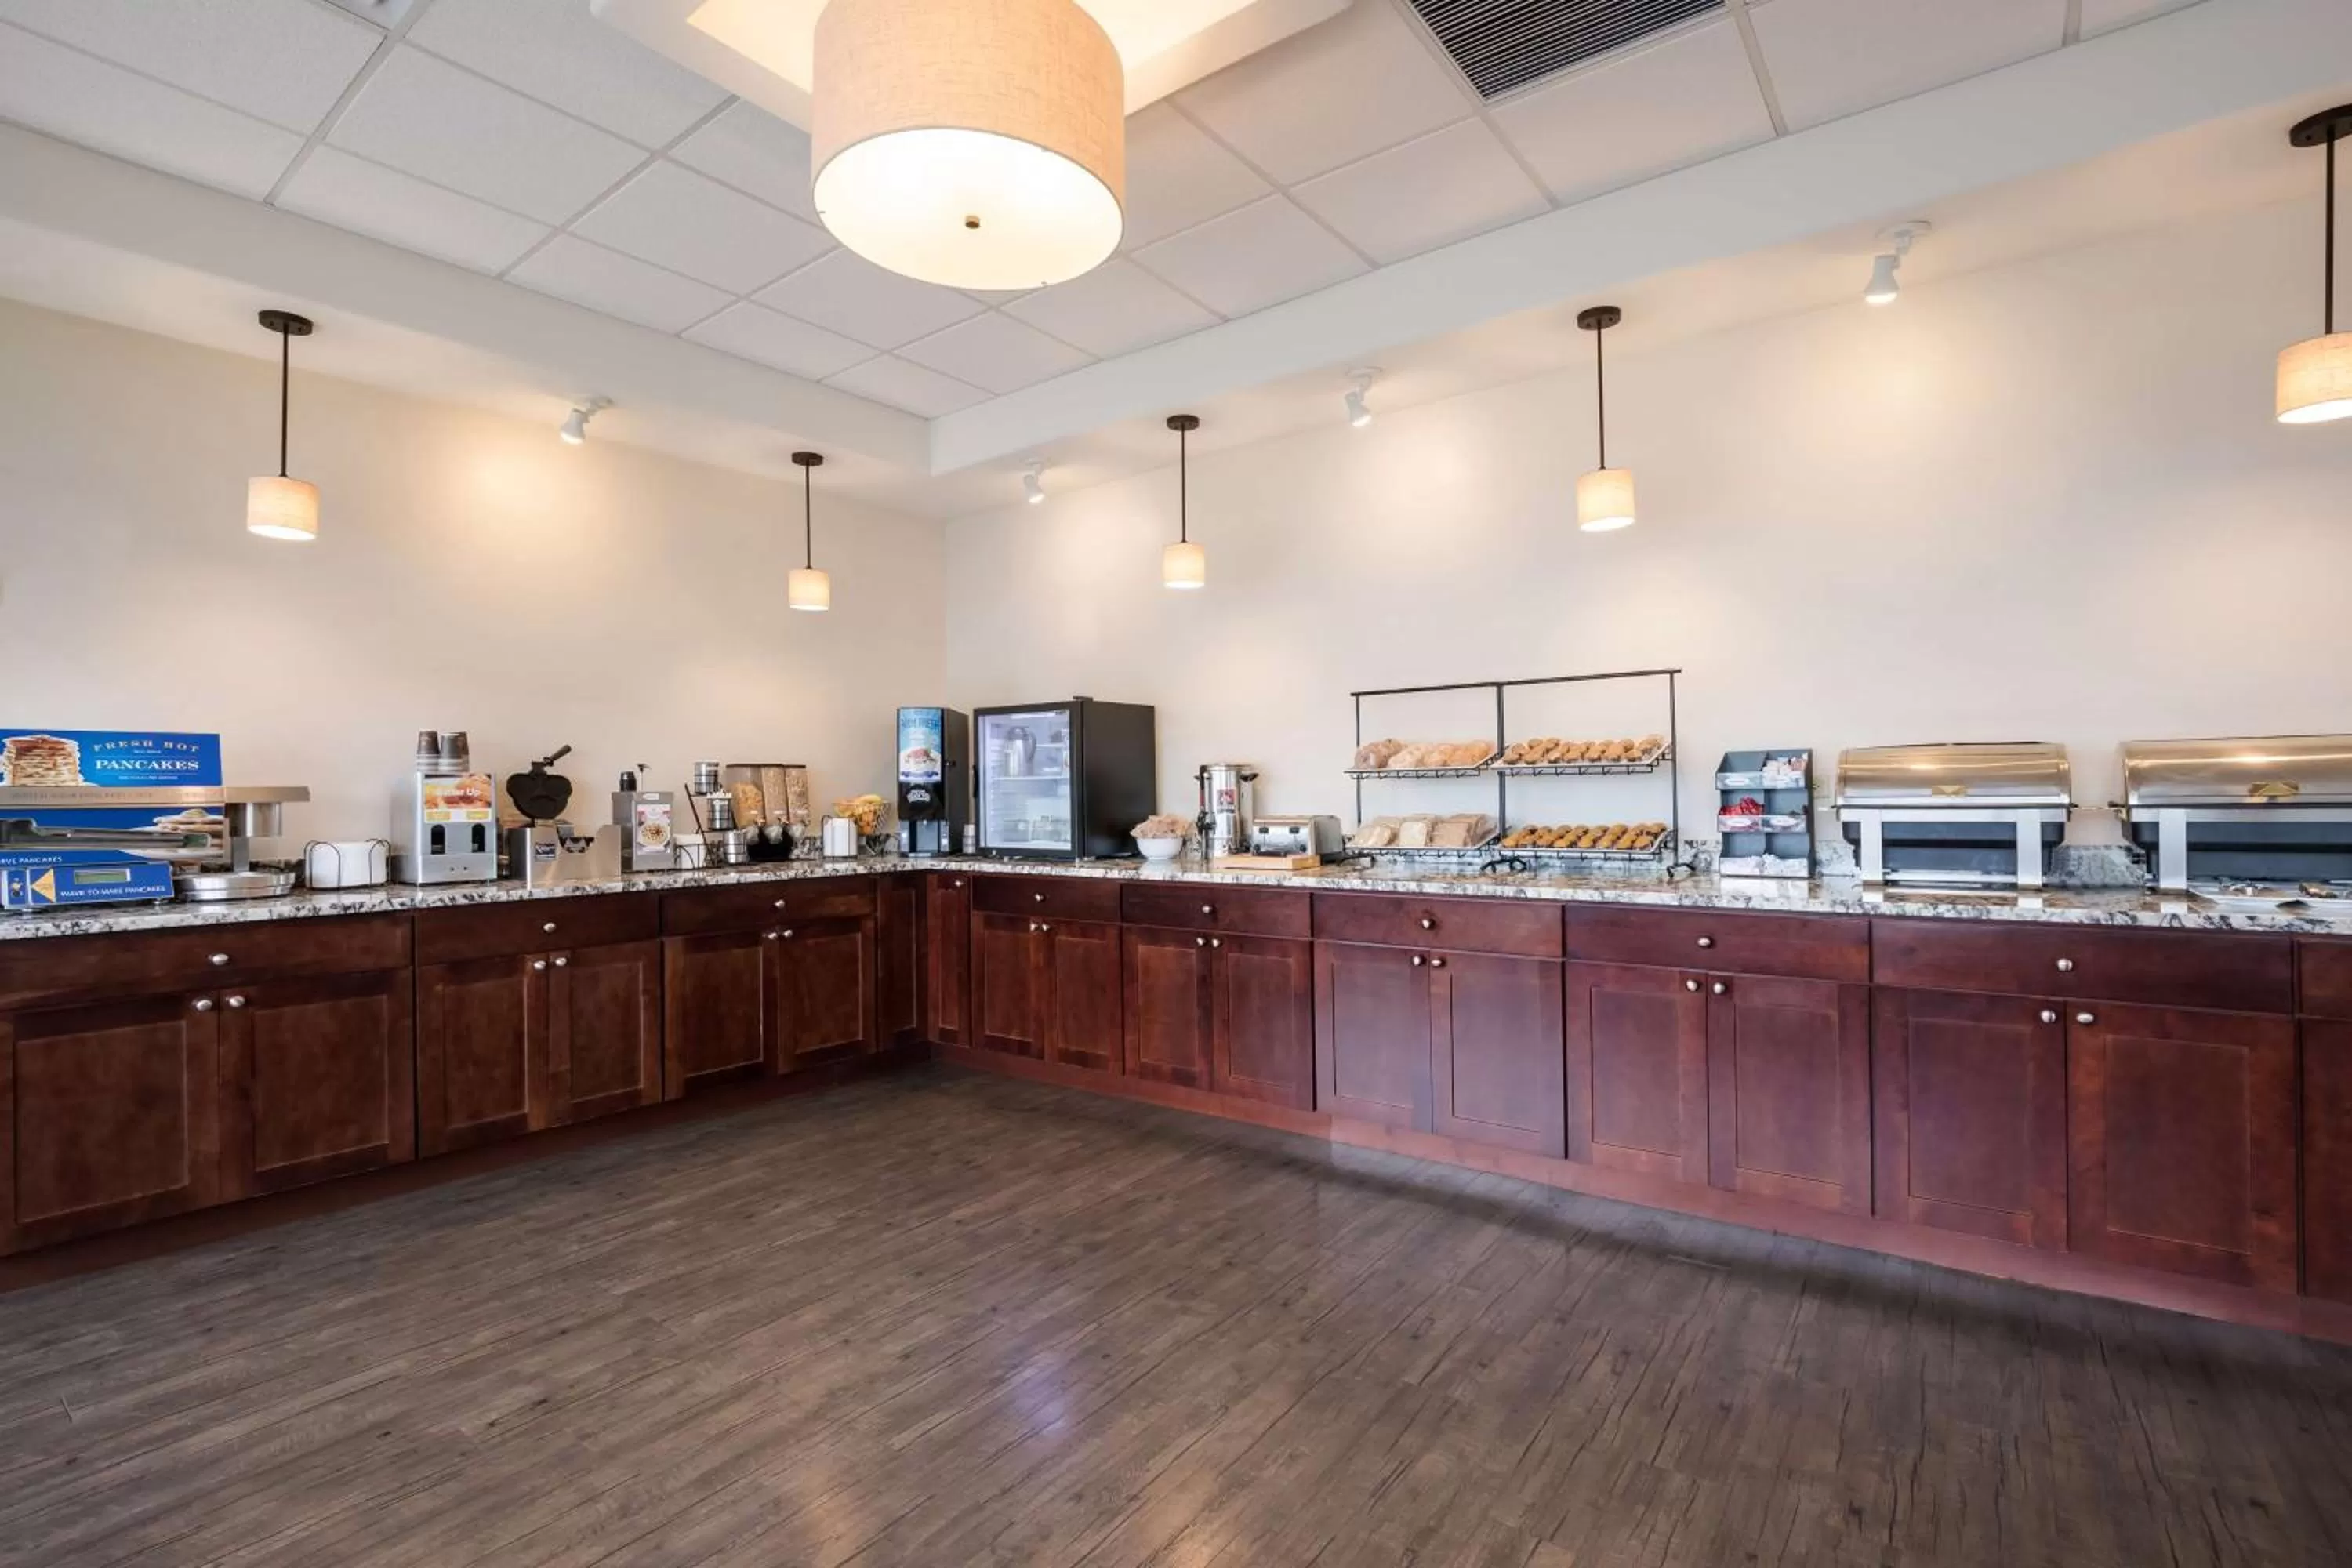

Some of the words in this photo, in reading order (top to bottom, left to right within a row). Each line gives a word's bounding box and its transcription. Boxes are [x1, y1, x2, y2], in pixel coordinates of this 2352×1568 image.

[93, 739, 154, 753] FRESH
[163, 741, 199, 753] HOT
[95, 760, 199, 770] PANCAKES
[125, 885, 165, 894] PANCAKES
